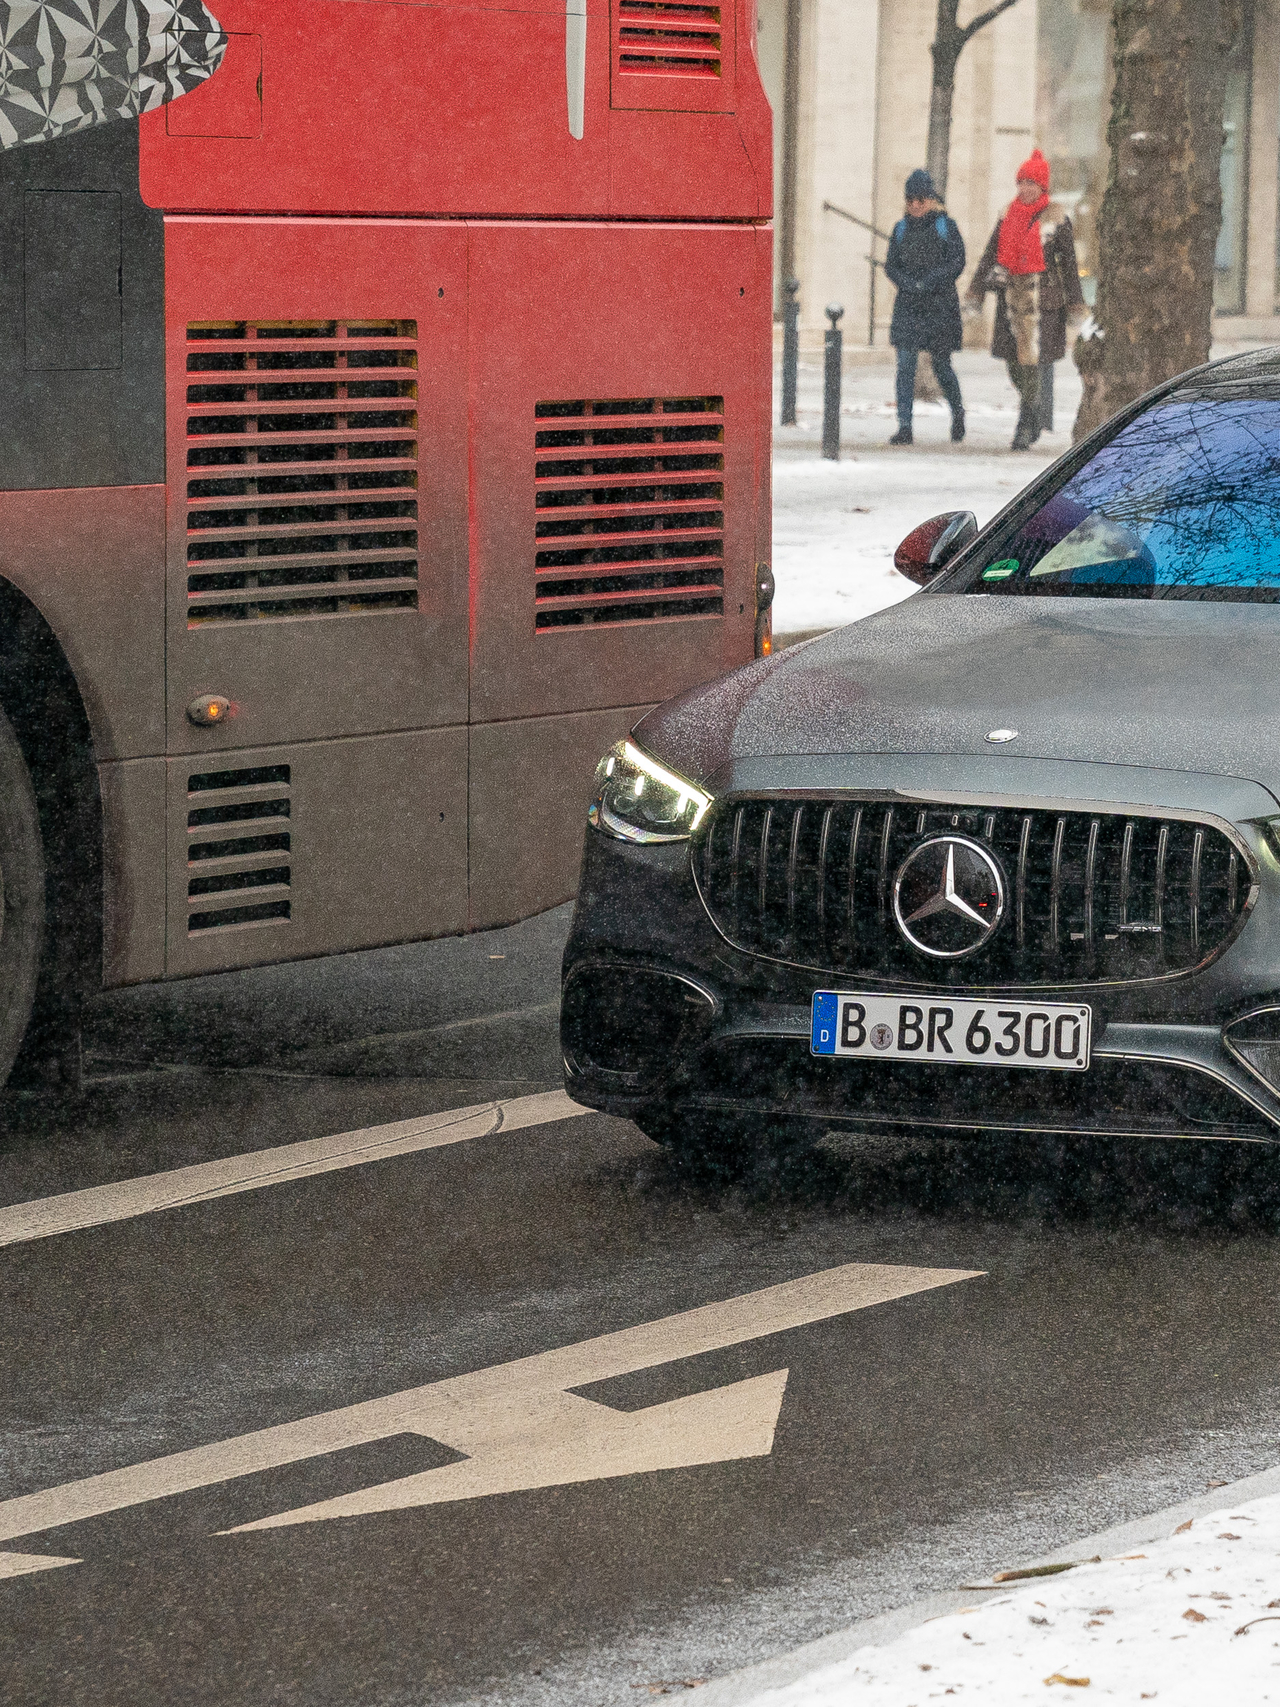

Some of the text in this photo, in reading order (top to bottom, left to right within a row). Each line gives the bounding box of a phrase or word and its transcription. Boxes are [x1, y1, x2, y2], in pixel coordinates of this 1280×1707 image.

[820, 1029, 829, 1043] D
[840, 1002, 1081, 1060] B BR 6300
